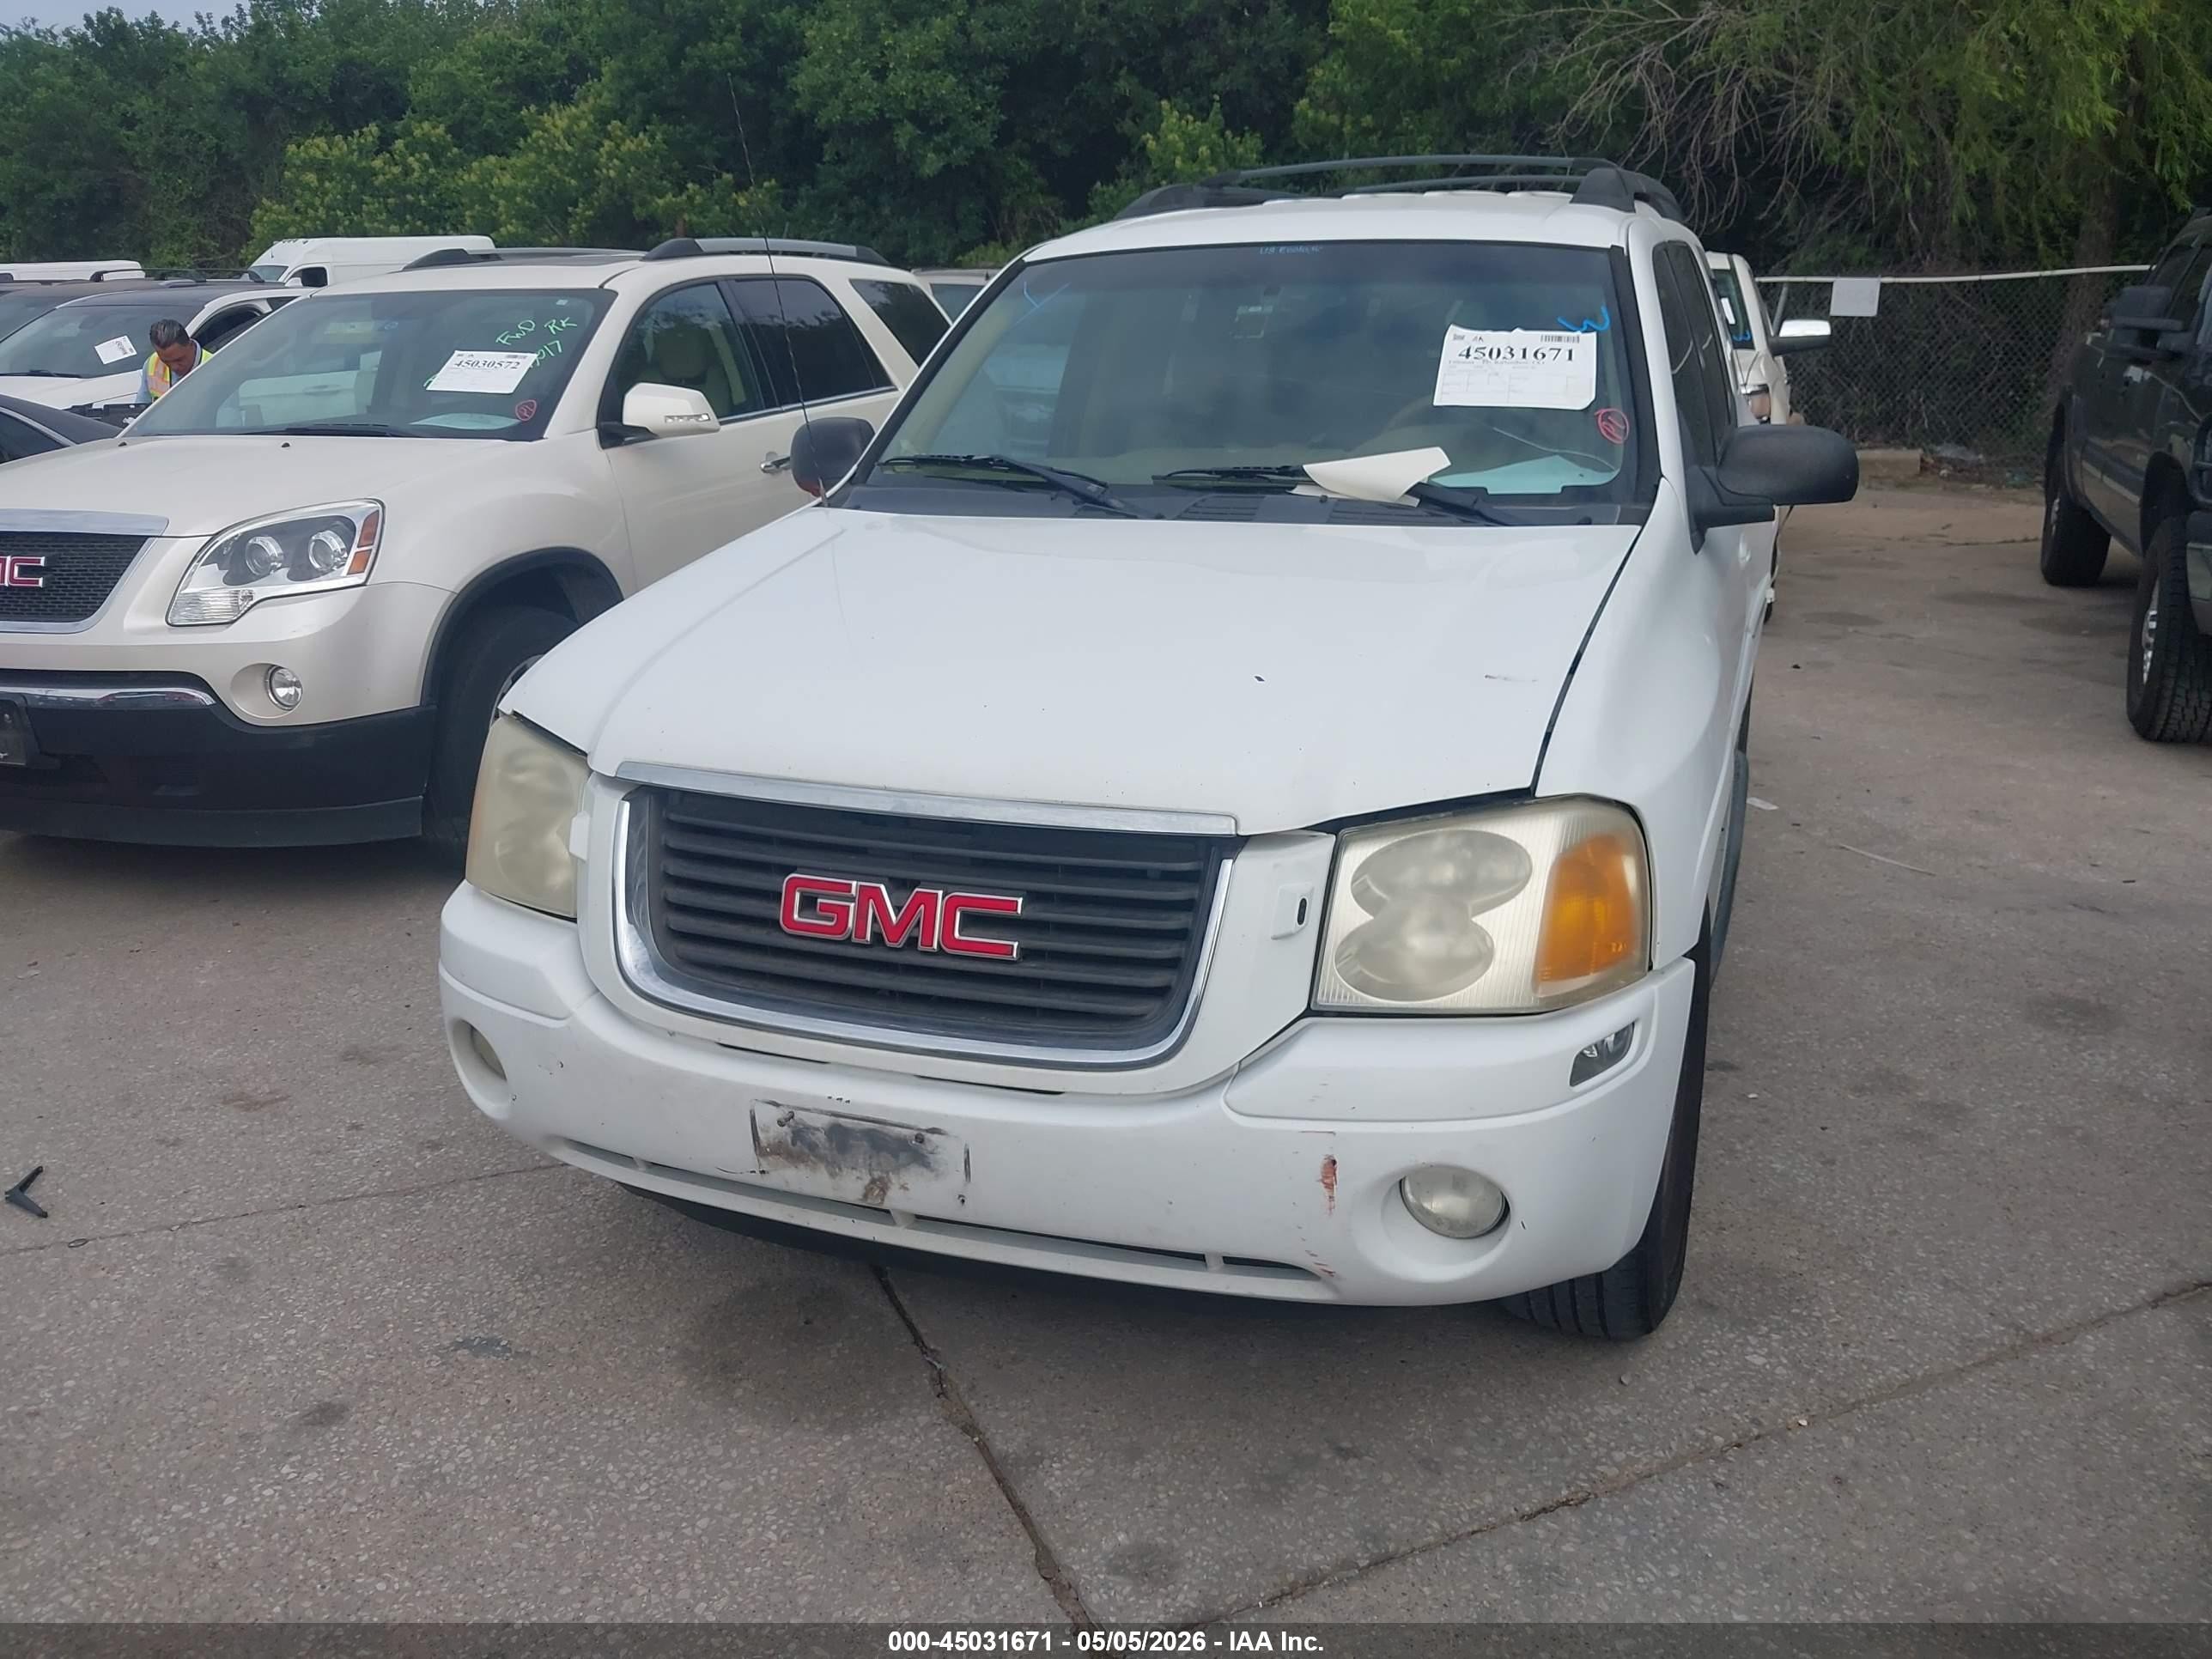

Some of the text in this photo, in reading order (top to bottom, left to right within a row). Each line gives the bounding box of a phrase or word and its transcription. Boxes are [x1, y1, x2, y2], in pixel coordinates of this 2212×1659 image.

[495, 319, 535, 345] FWD
[453, 359, 520, 369] 45030572
[1458, 345, 1574, 362] 45031671
[780, 872, 1023, 961] GMC
